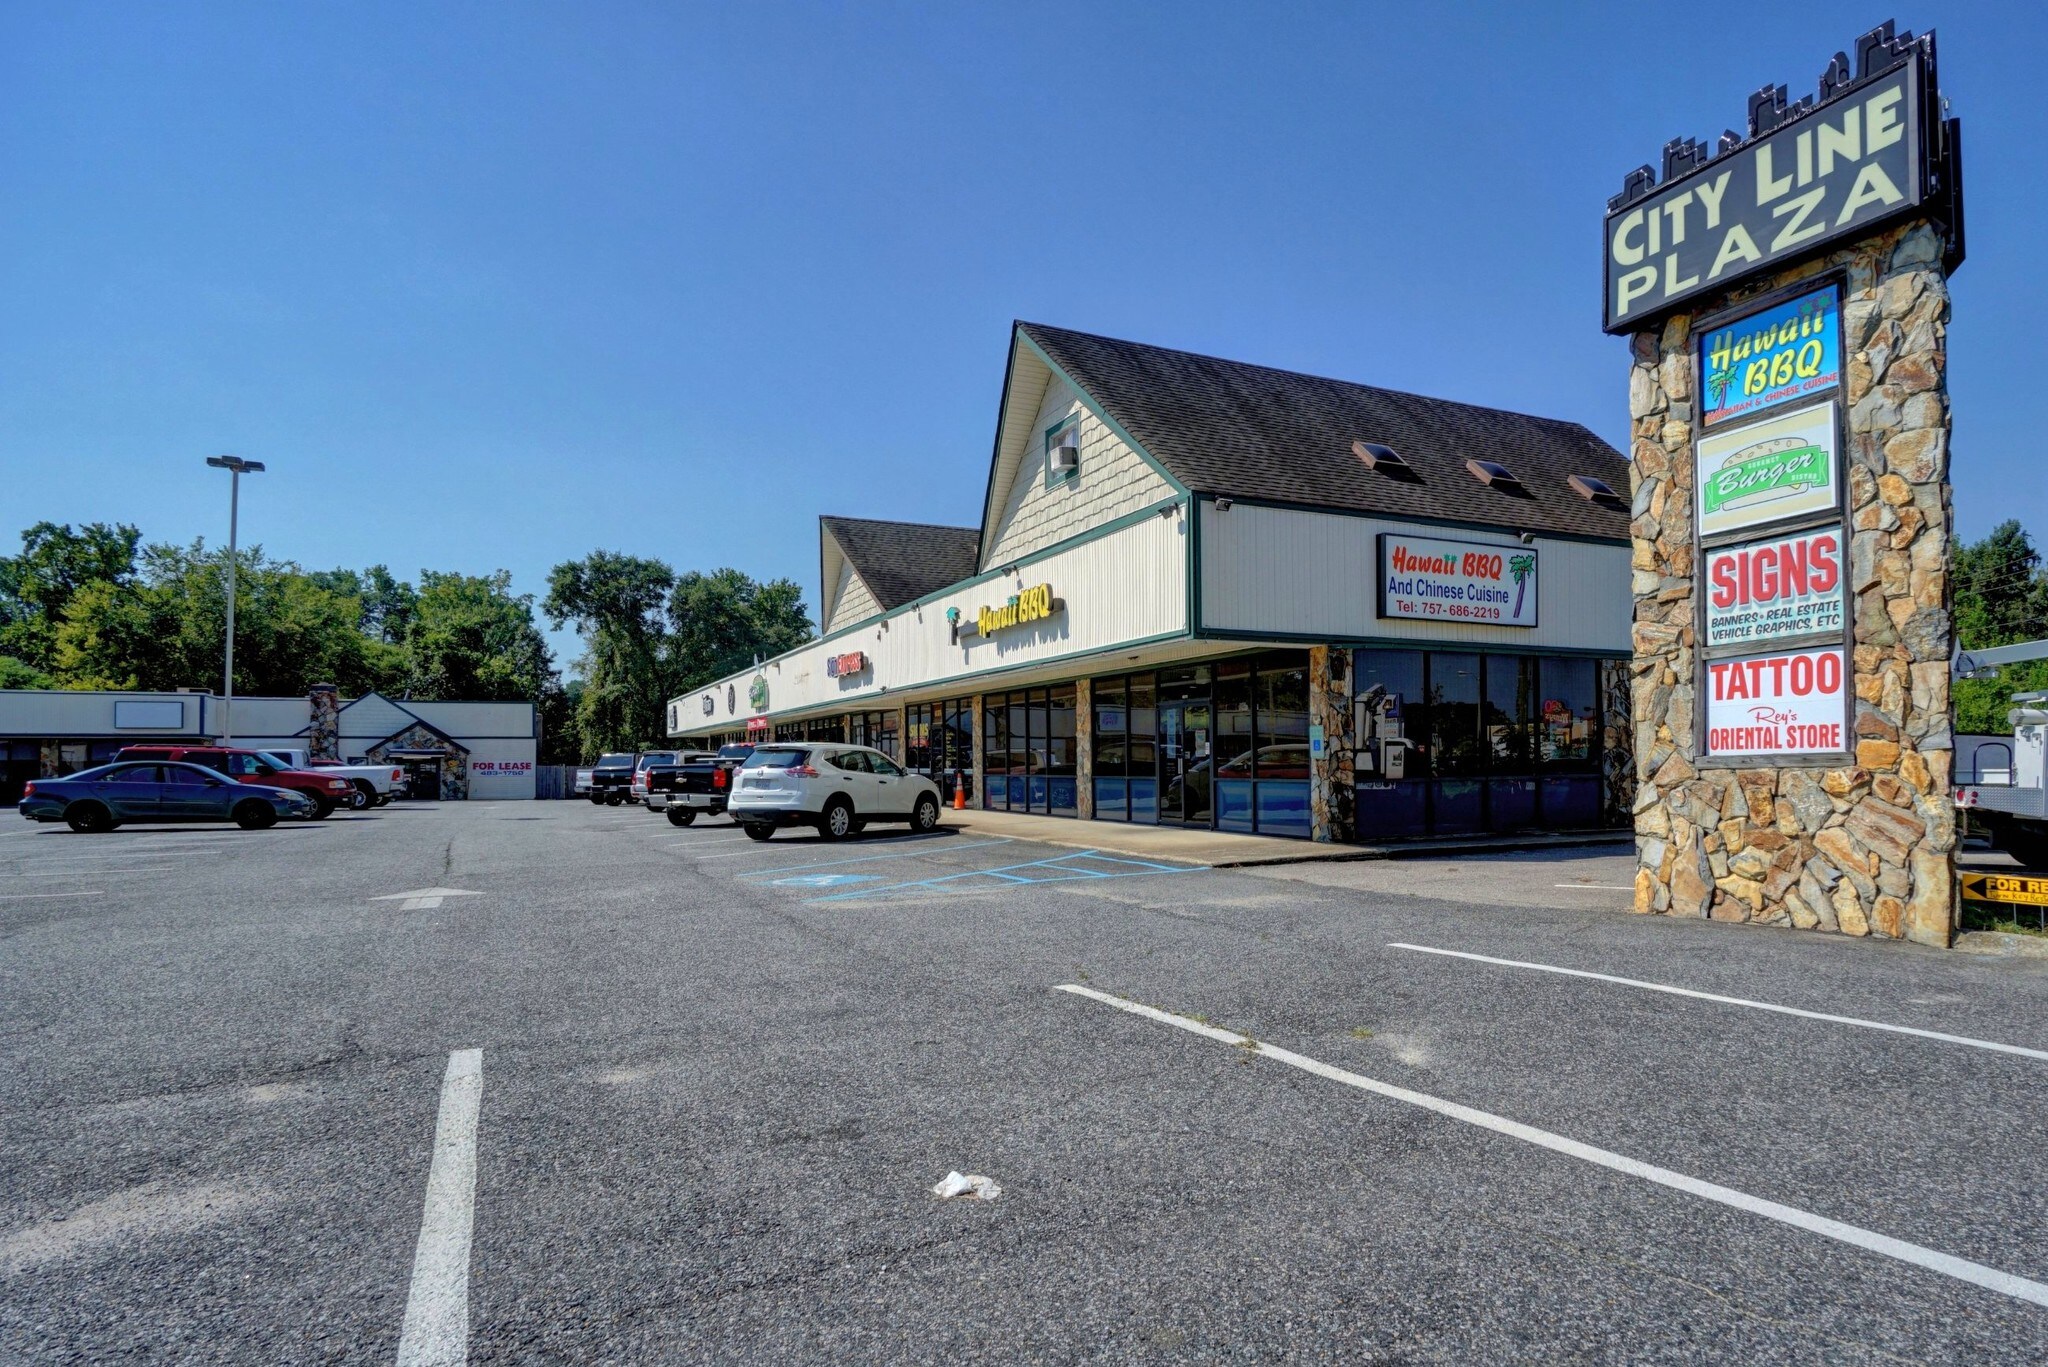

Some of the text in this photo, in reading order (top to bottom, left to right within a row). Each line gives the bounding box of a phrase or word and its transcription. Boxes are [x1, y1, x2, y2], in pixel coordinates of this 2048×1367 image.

[1612, 85, 1905, 267] CITY LINE
[1617, 161, 1905, 317] PLAZA
[1710, 302, 1827, 371] Hawaii
[1743, 339, 1823, 396] BBQ
[1755, 398, 1762, 406] &
[1764, 384, 1799, 403] CHINESE
[1802, 372, 1838, 391] CUISINE
[1716, 452, 1815, 496] Burger
[1392, 545, 1503, 581] Hawaii BBQ
[1711, 535, 1839, 609] SIGNS
[1388, 576, 1509, 603] And Chinese Cuisine
[1396, 599, 1418, 613] Tel:
[978, 583, 1051, 638] Hawaii BBQ
[1711, 600, 1840, 629] BANNERS REAL ESTATE
[1711, 613, 1840, 641] VEHICLE GRAPHICS, ETC
[1710, 652, 1841, 701] TATTOO
[1747, 706, 1798, 725] Rey's
[1710, 723, 1840, 751] ORIENTAL STORE
[1985, 878, 2021, 891] FOR
